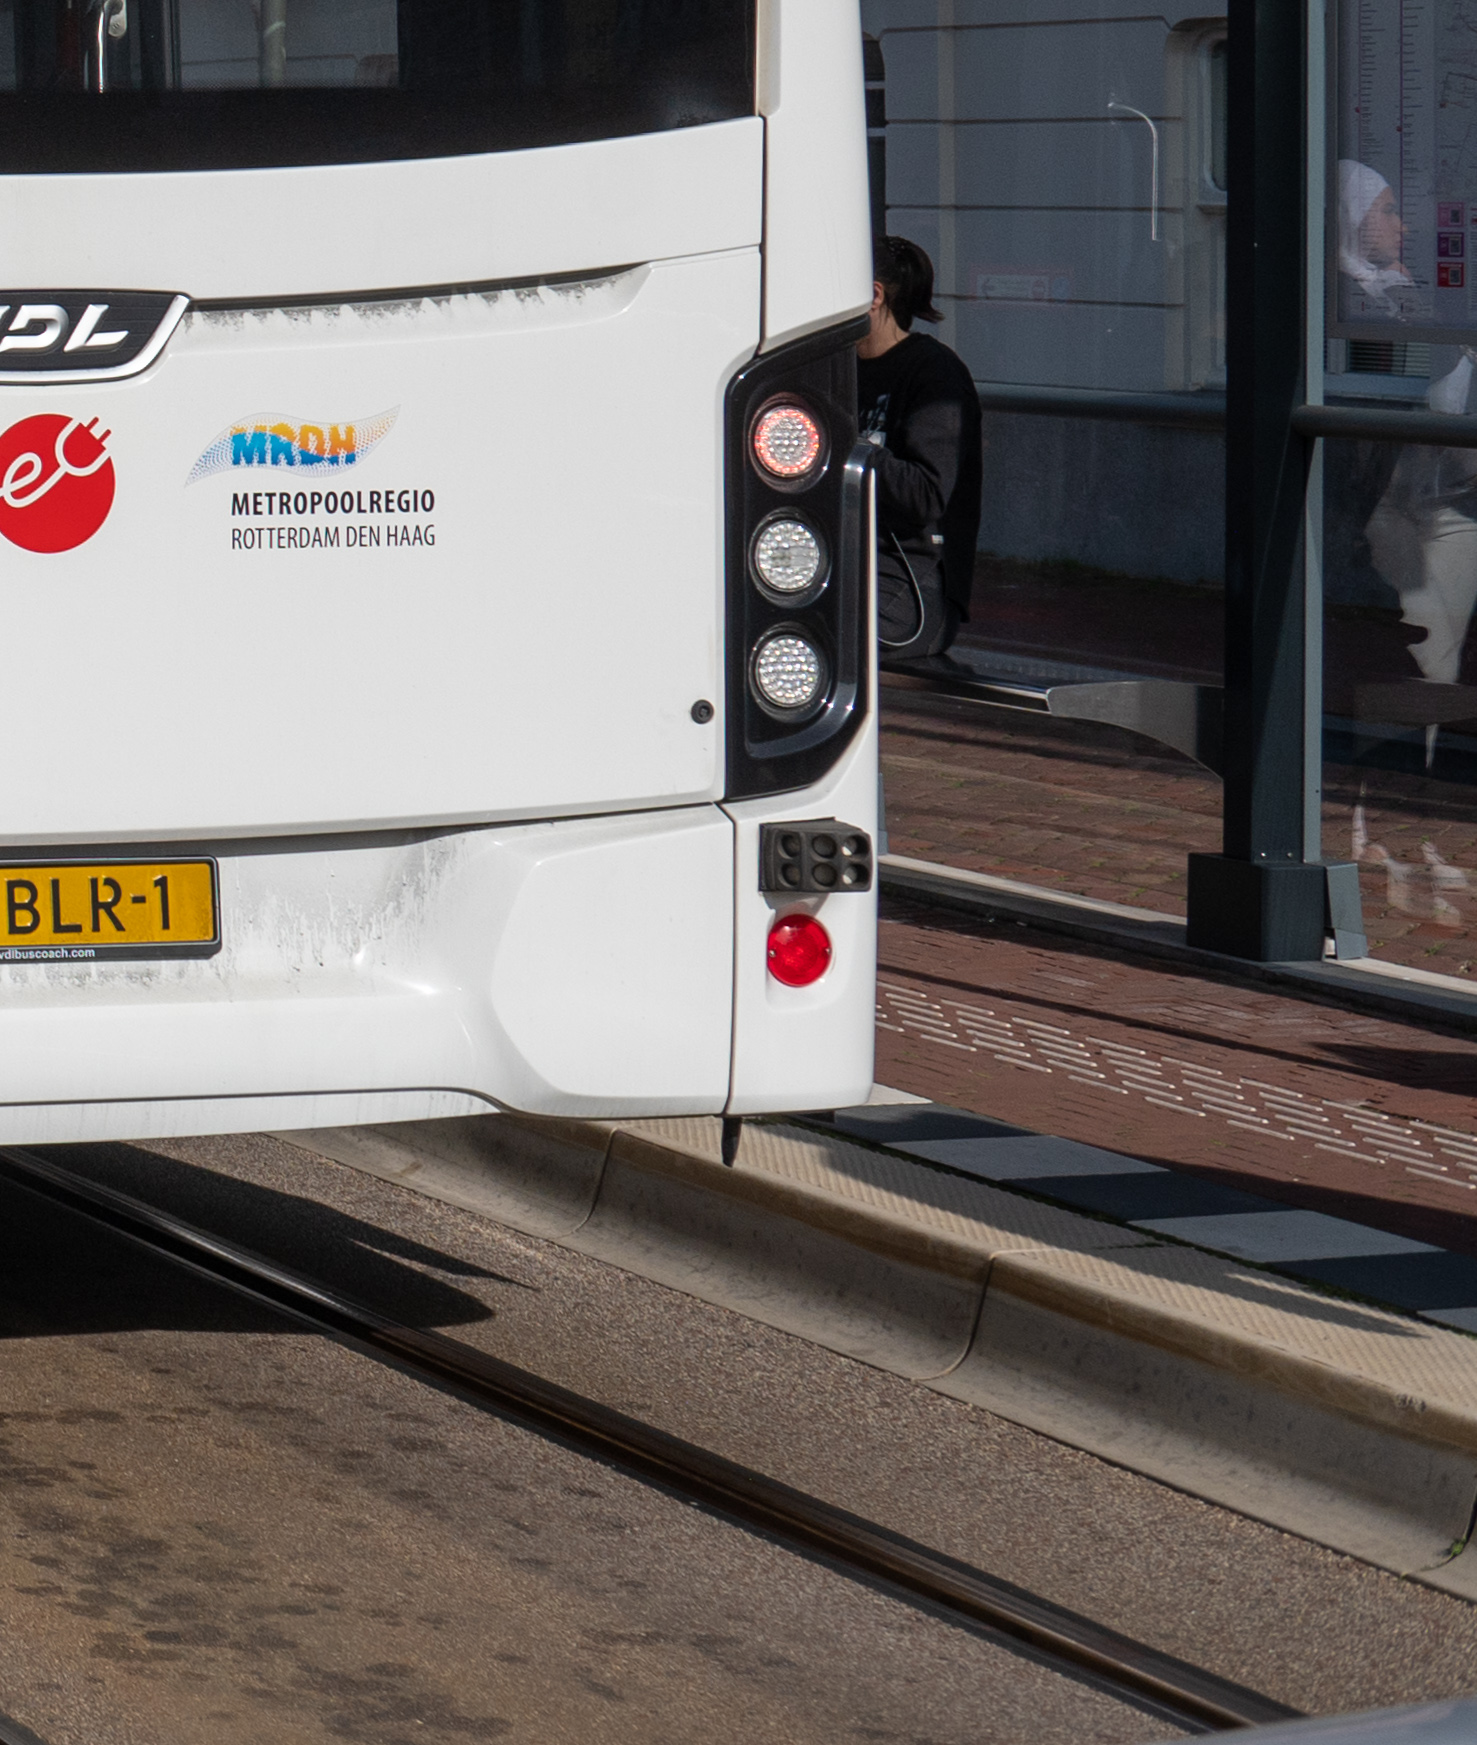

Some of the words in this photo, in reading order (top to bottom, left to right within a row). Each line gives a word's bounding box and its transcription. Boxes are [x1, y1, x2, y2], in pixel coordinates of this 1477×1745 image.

[230, 423, 357, 467] MRDH
[231, 489, 436, 516] METROPOOLREGIO
[232, 526, 340, 549] ROTTERDAM
[346, 526, 381, 548] DEN
[387, 524, 436, 546] HAAG
